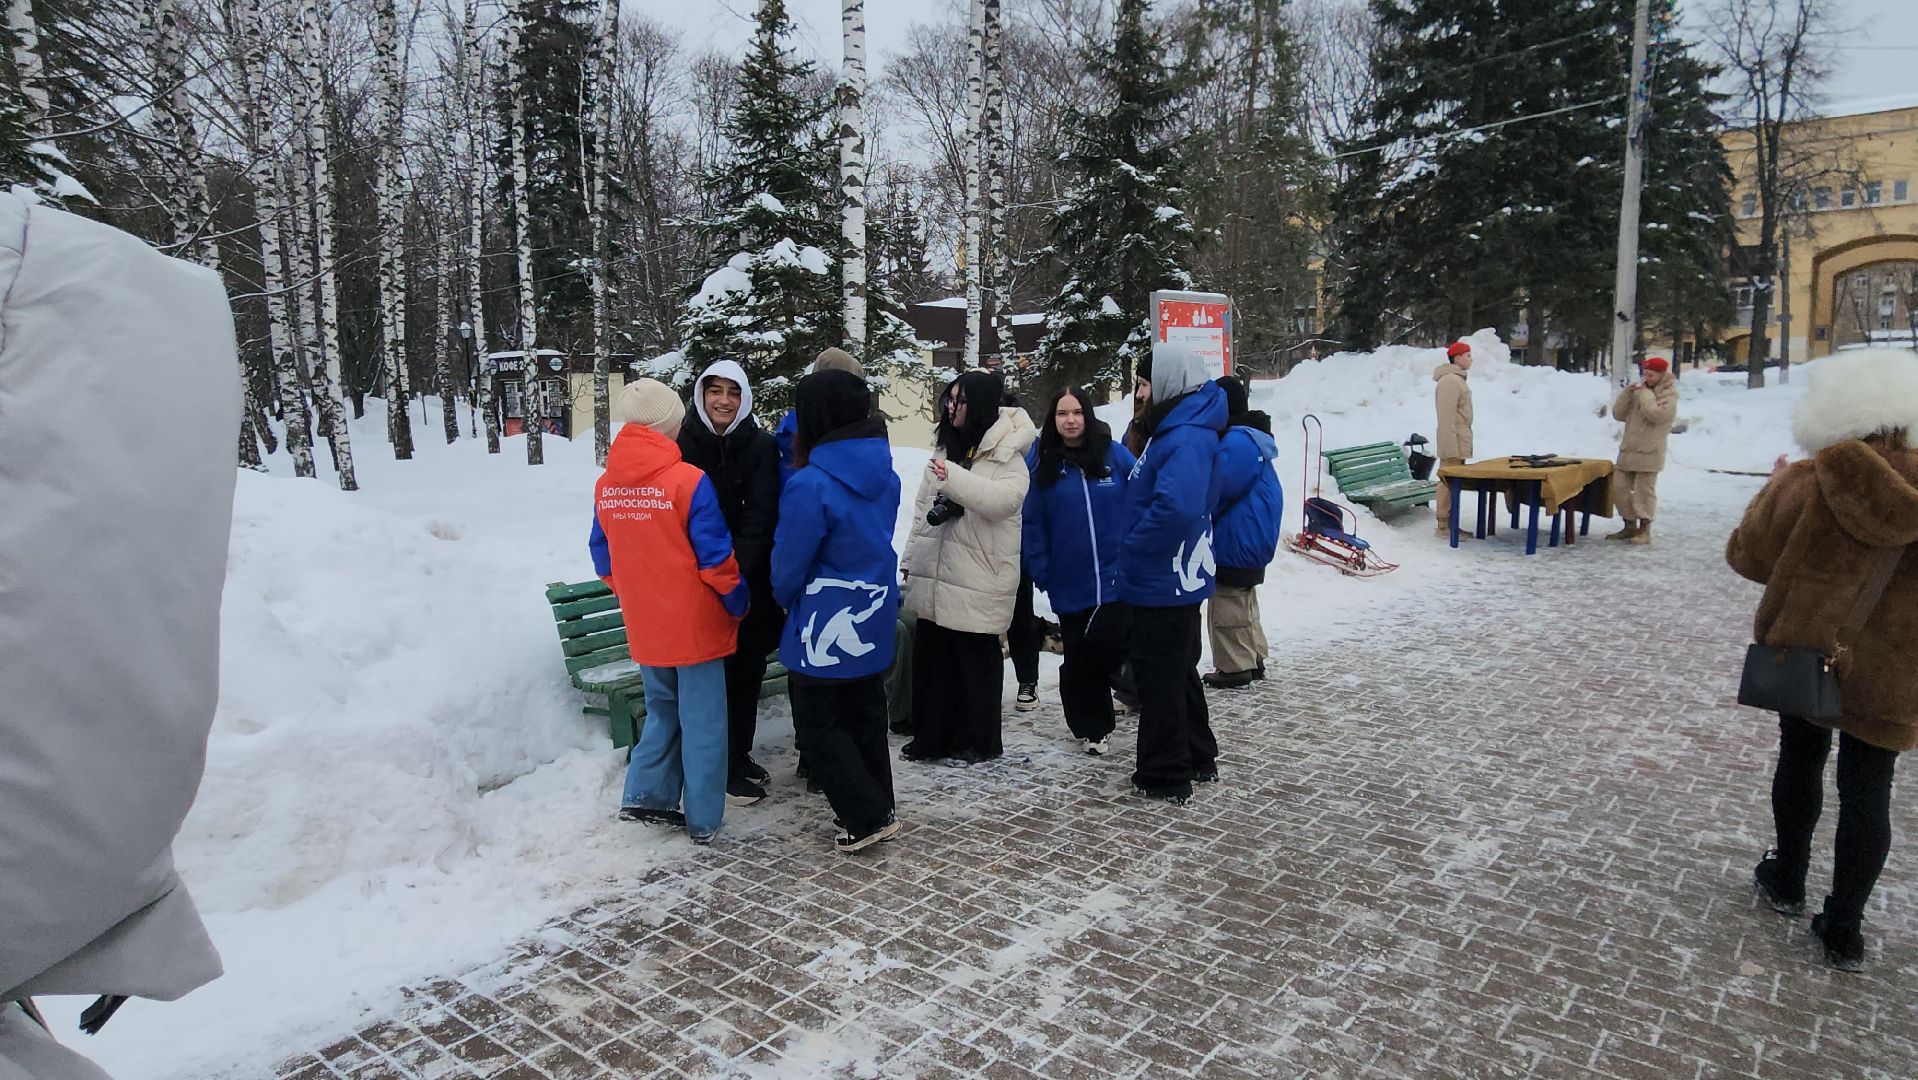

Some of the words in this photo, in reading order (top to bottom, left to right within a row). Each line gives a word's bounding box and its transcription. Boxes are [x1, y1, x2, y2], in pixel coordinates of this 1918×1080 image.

[499, 361, 518, 372] КОФЕ
[602, 487, 665, 498] ВОЛОНТЕРЫ
[598, 499, 673, 511] ПОДМОСКОВЬЯ
[628, 513, 652, 521] РЯДОМ
